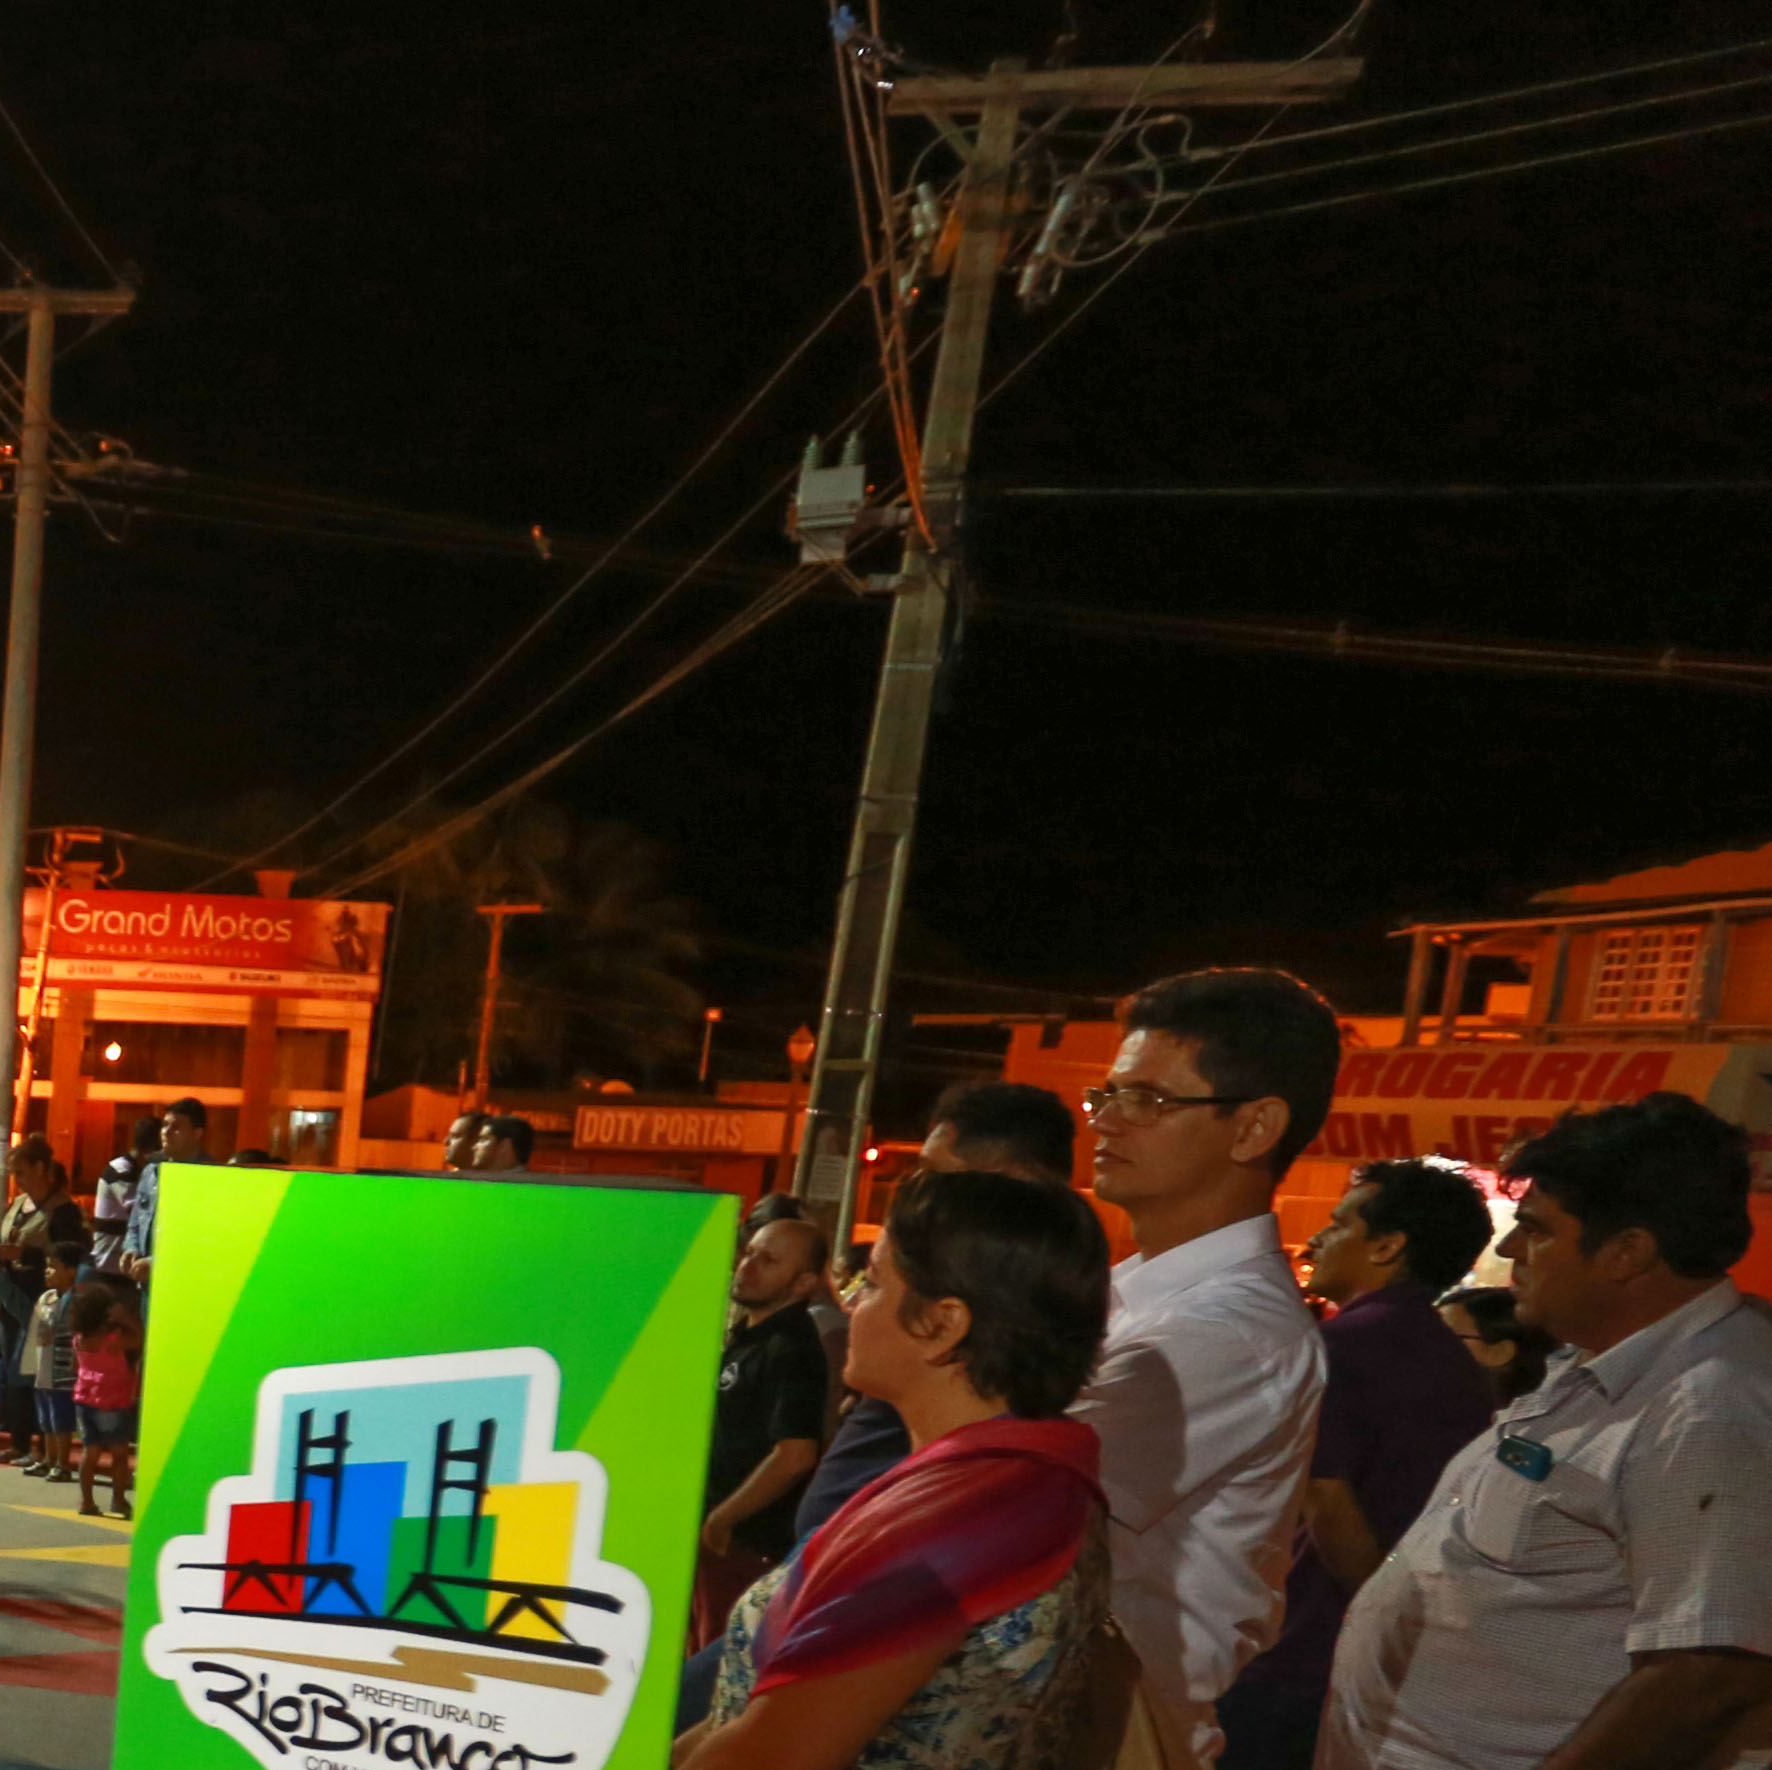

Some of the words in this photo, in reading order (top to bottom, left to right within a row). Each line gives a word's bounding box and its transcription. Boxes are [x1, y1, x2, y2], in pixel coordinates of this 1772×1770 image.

[58, 898, 172, 937] Grand
[180, 903, 293, 943] Motos
[1336, 1050, 1673, 1100] ROGARIA
[581, 1110, 646, 1144] DOTY
[651, 1112, 744, 1147] PORTAS
[352, 1682, 473, 1728] PREFEITURA
[477, 1711, 506, 1733] DE
